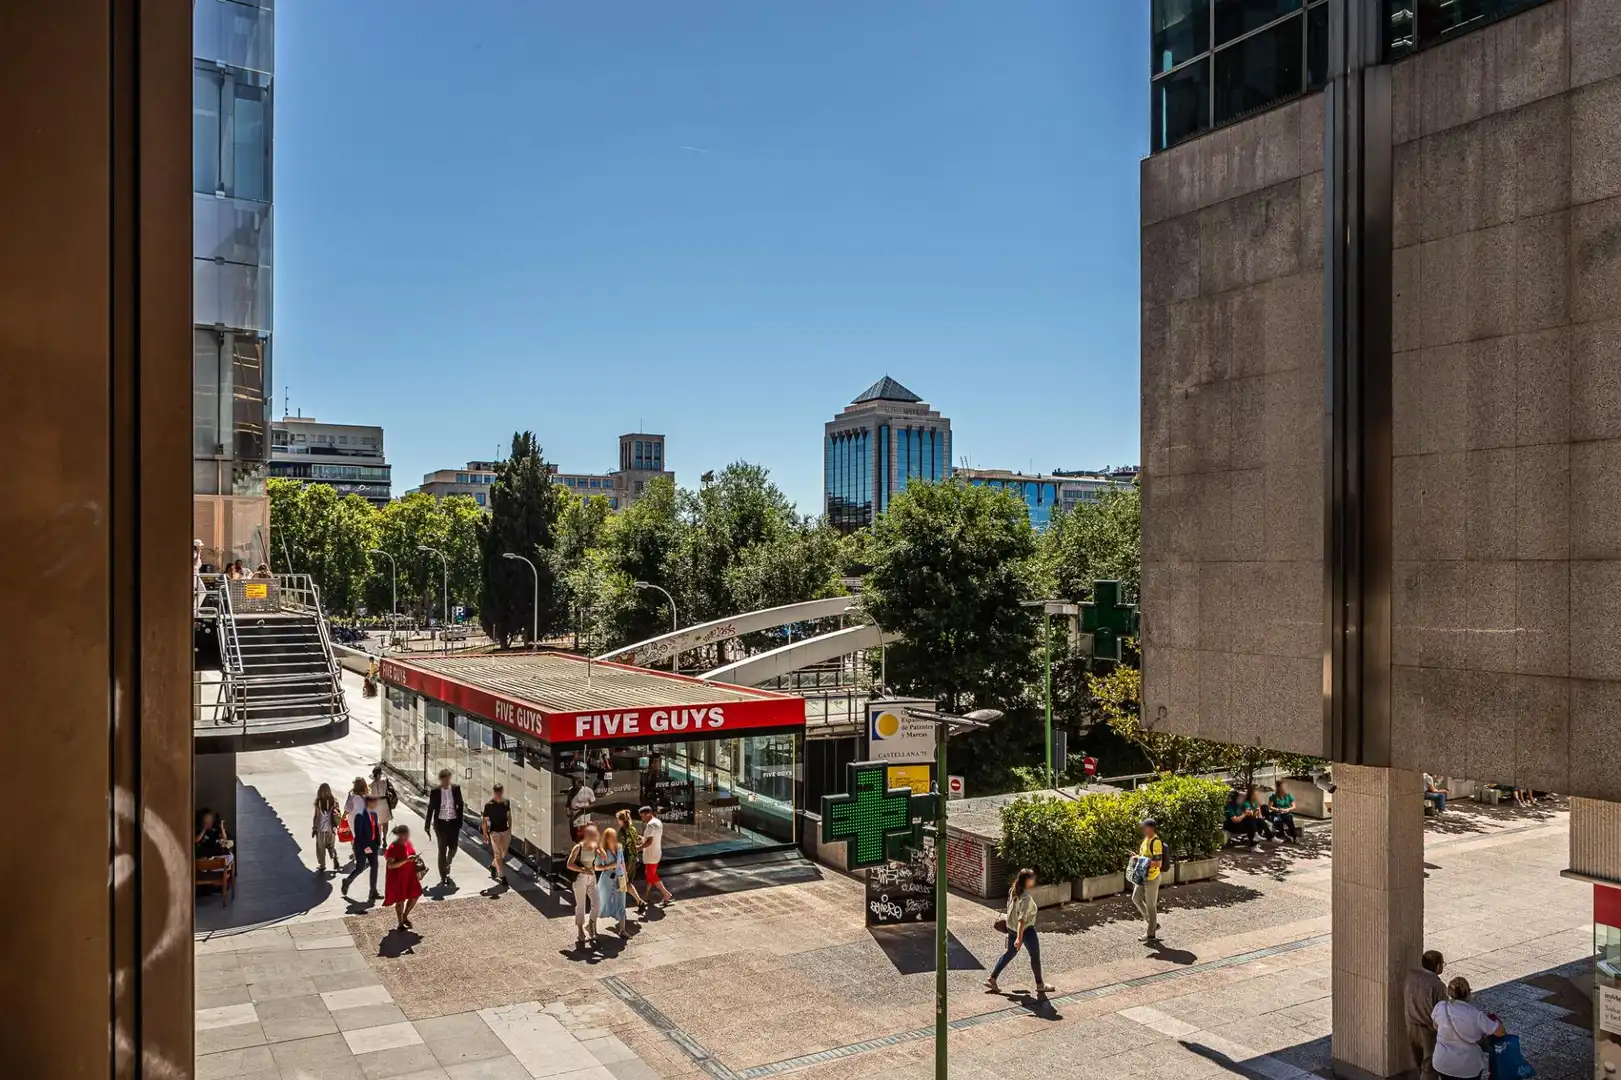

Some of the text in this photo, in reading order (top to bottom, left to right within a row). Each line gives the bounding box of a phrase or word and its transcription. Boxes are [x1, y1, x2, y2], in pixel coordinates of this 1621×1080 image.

[382, 663, 407, 684] FIVE GUYS
[495, 700, 543, 735] FIVE GUYS
[576, 707, 724, 737] FIVE GUYS
